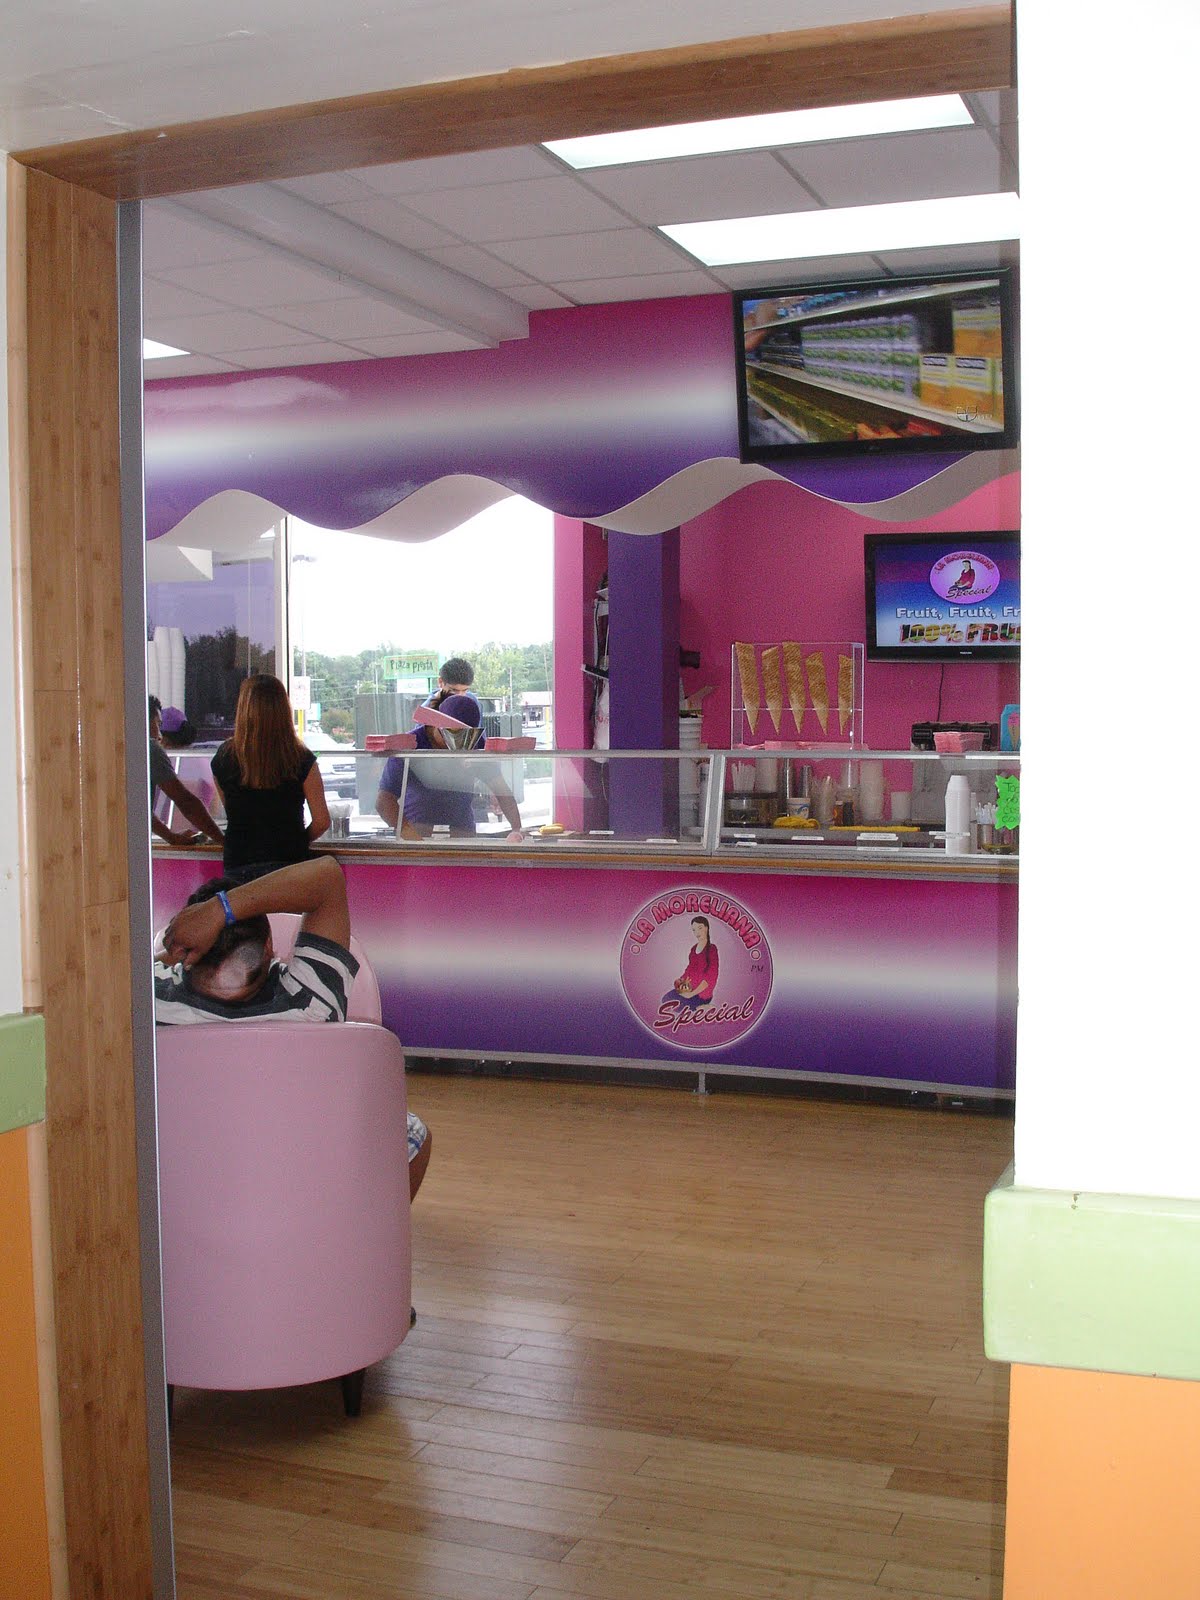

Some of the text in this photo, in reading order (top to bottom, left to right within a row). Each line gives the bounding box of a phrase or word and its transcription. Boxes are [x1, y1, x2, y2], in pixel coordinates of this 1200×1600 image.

[945, 585, 992, 599] Special
[896, 607, 943, 620] Fruit,
[949, 606, 996, 619] Fruit,
[900, 623, 964, 643] 100%
[629, 893, 763, 949] LA MORELIANA
[653, 995, 755, 1034] Special
